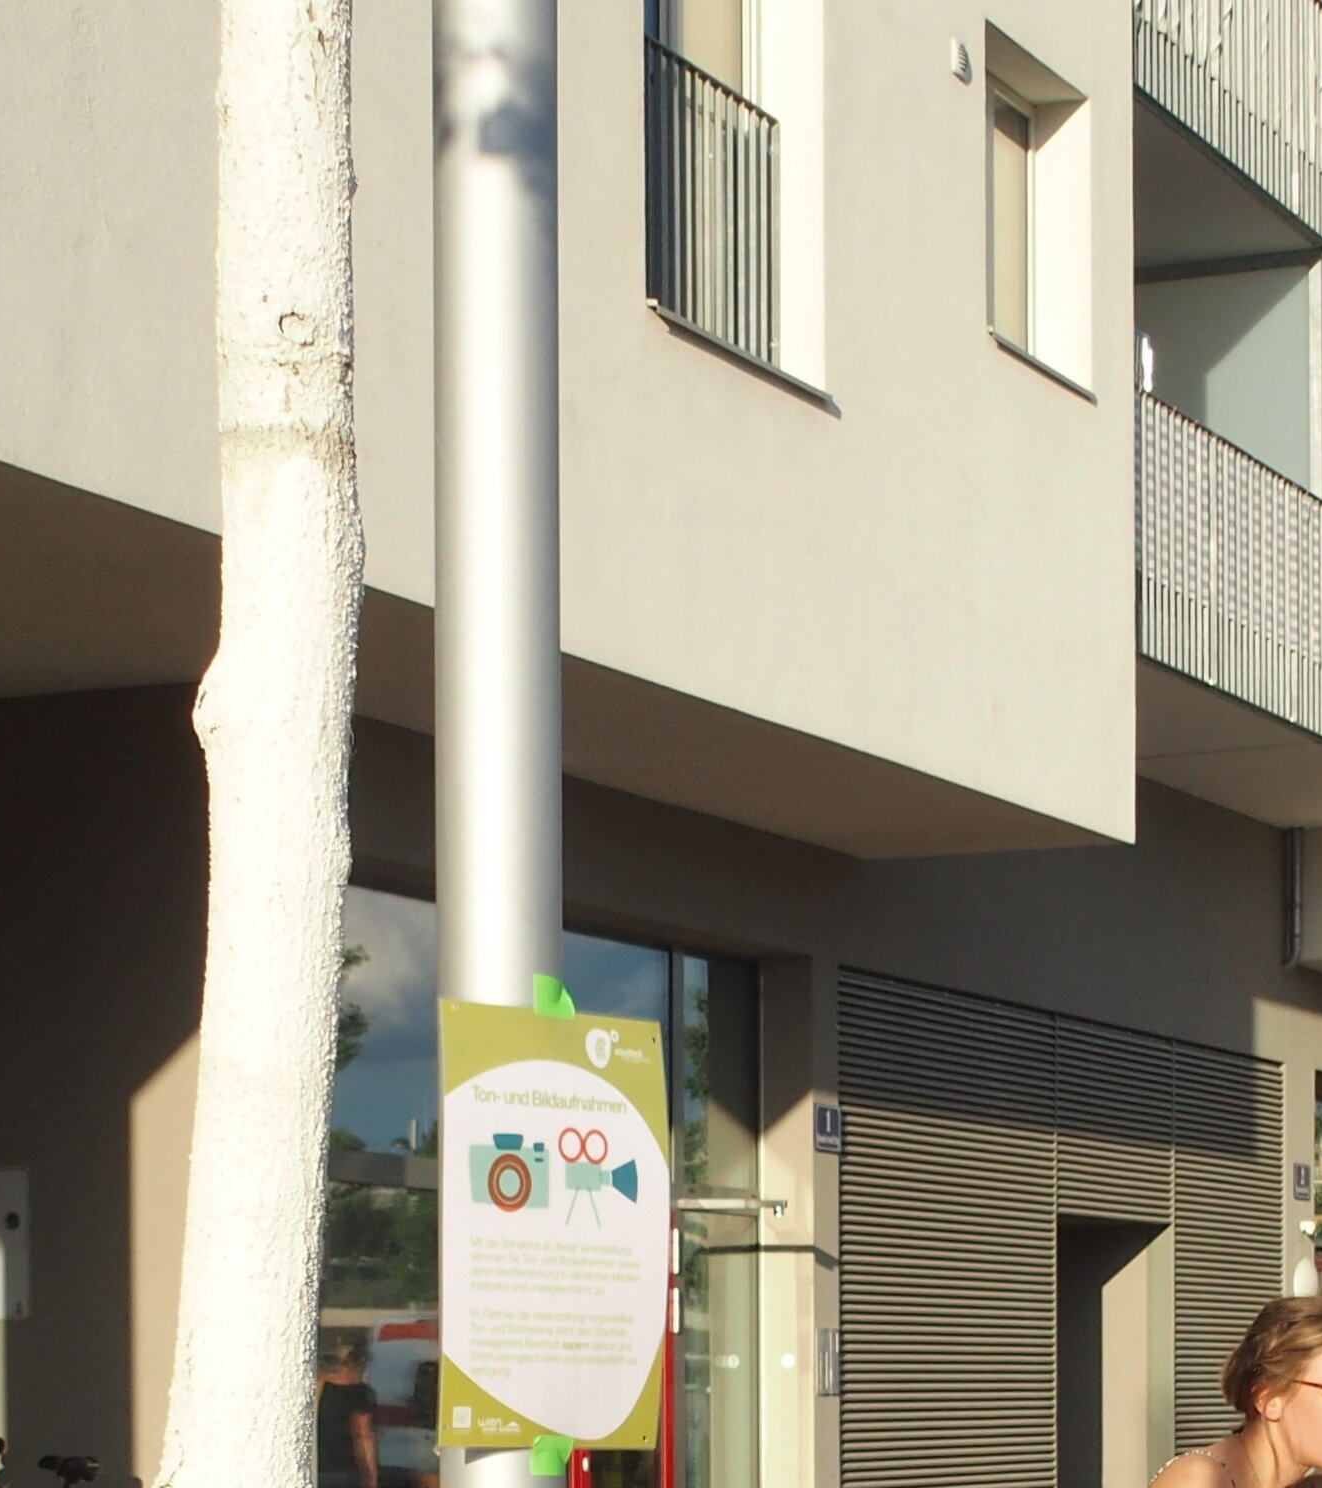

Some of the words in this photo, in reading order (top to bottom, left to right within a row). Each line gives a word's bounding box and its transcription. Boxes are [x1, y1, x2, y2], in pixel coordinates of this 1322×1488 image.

[472, 1085, 501, 1103] Ton-
[504, 1091, 529, 1106] und
[532, 1090, 627, 1114] Bildaufnahmen
